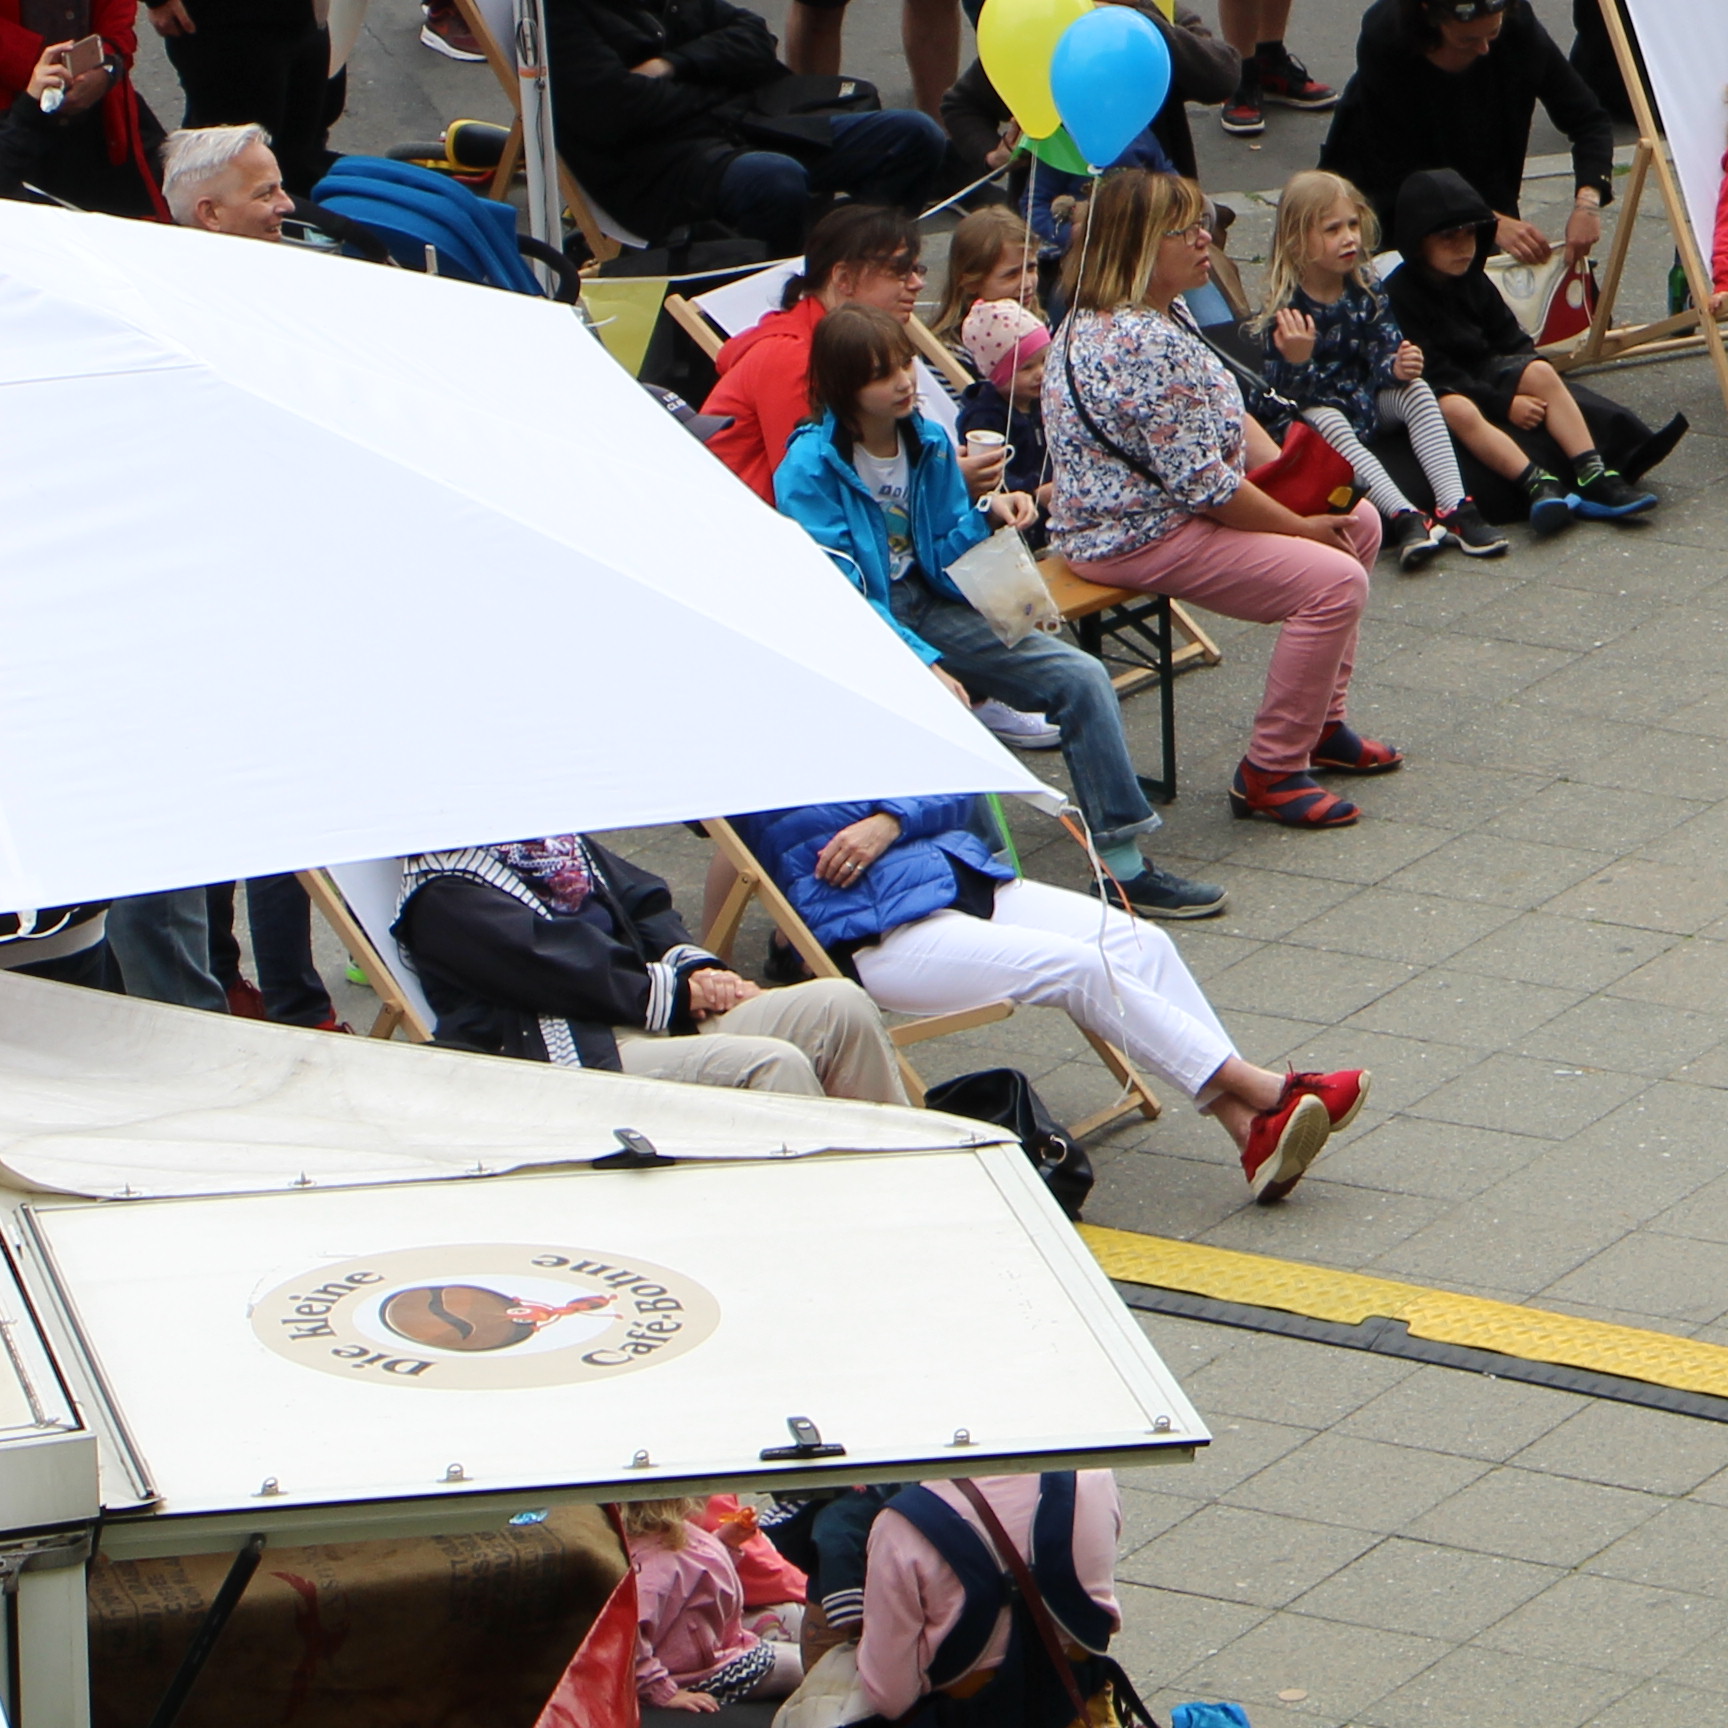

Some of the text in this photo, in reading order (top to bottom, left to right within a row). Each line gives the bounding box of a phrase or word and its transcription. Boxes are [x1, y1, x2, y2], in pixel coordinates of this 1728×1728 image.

[280, 1269, 438, 1378] Die kleine
[530, 1252, 687, 1370] Café-Bohne
